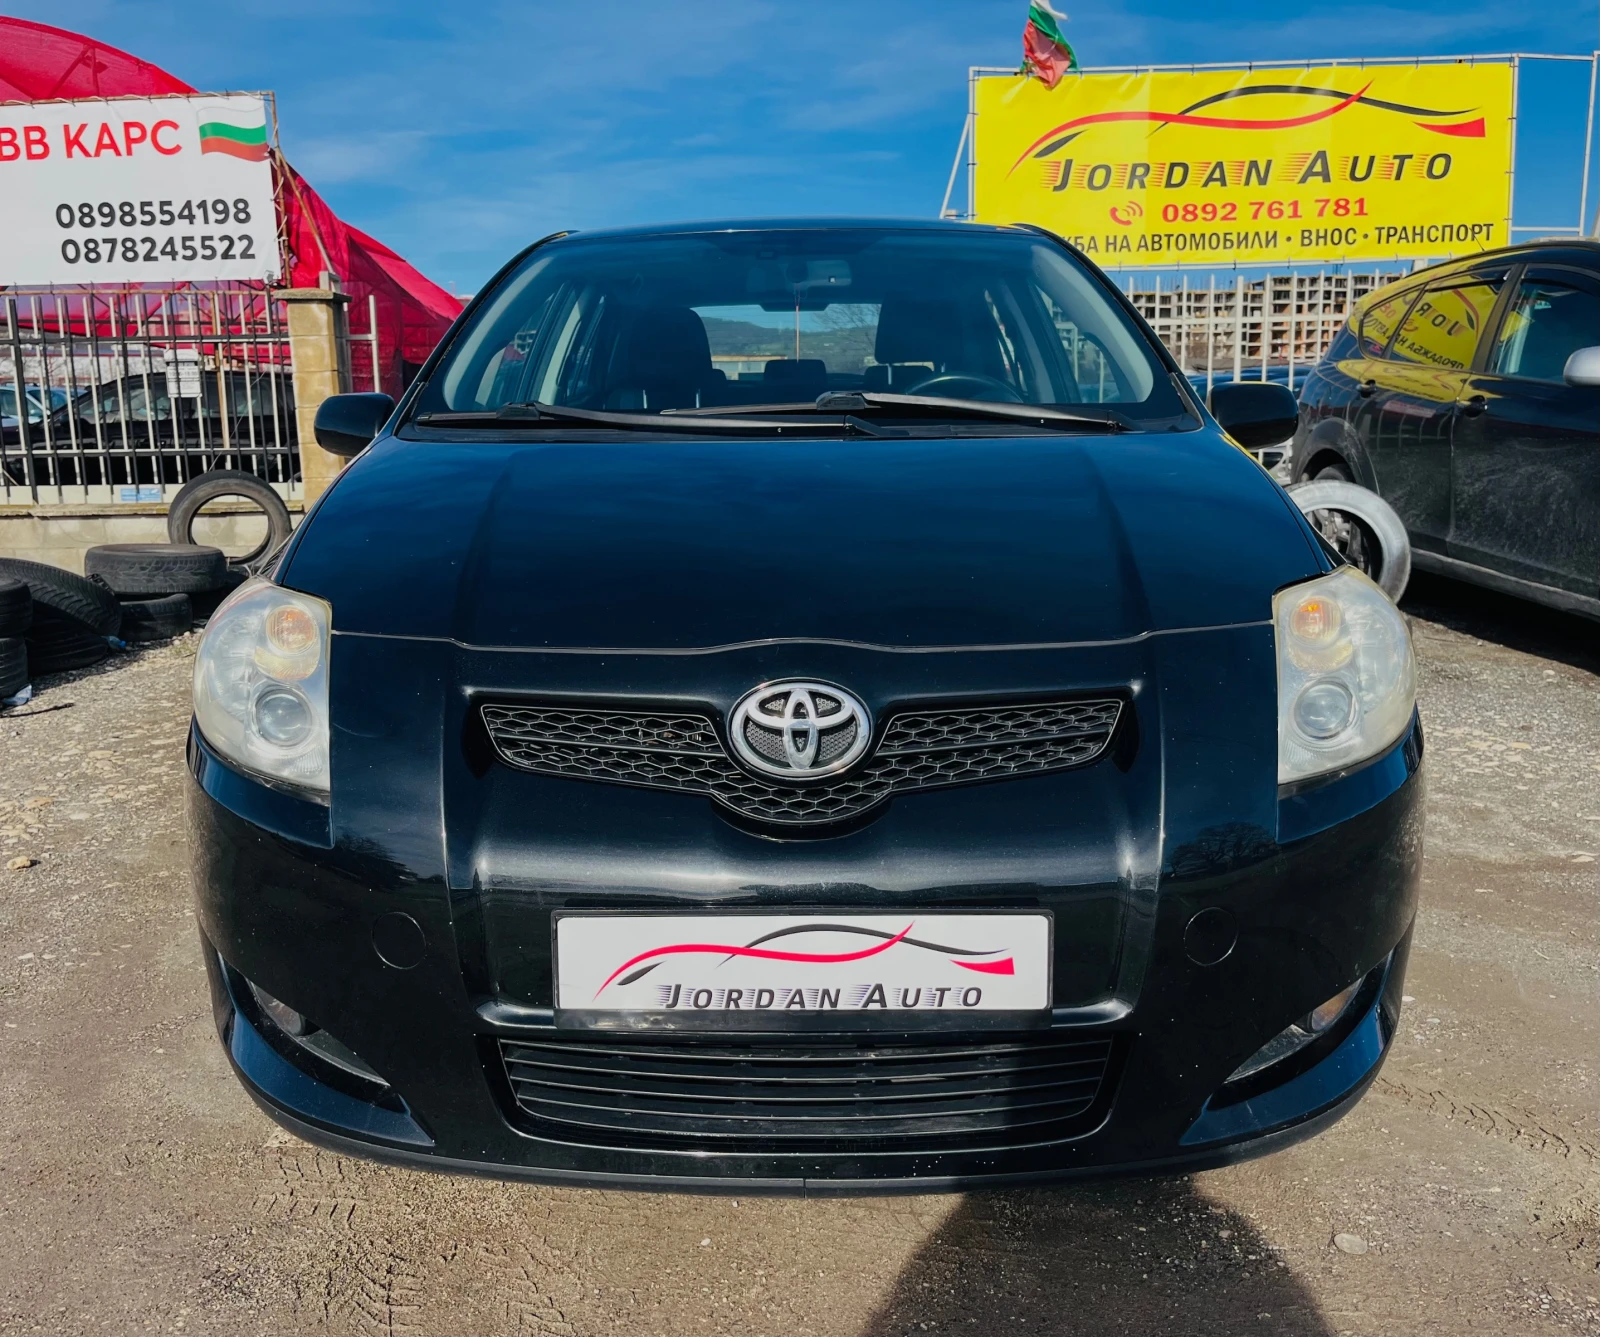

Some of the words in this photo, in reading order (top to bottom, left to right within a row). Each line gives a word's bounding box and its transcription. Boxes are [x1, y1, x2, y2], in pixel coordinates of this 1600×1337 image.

[63, 119, 182, 159] КАРС
[1051, 158, 1272, 192] JORDAN
[1297, 150, 1452, 185] AUTO
[56, 198, 251, 229] 0898554198
[1161, 202, 1238, 223] 0892
[1249, 200, 1303, 220] 761
[1314, 197, 1369, 218] 781
[61, 234, 256, 265] 0878245522
[1062, 235, 1099, 254] БА
[1105, 234, 1133, 254] НА
[1136, 230, 1278, 254] АВТОМОБИЛИ
[1300, 227, 1358, 248] ВНОС
[1374, 222, 1495, 245] ТРАНСПОРТ
[665, 983, 841, 1010] JORDAN
[861, 983, 982, 1009] AUTO
